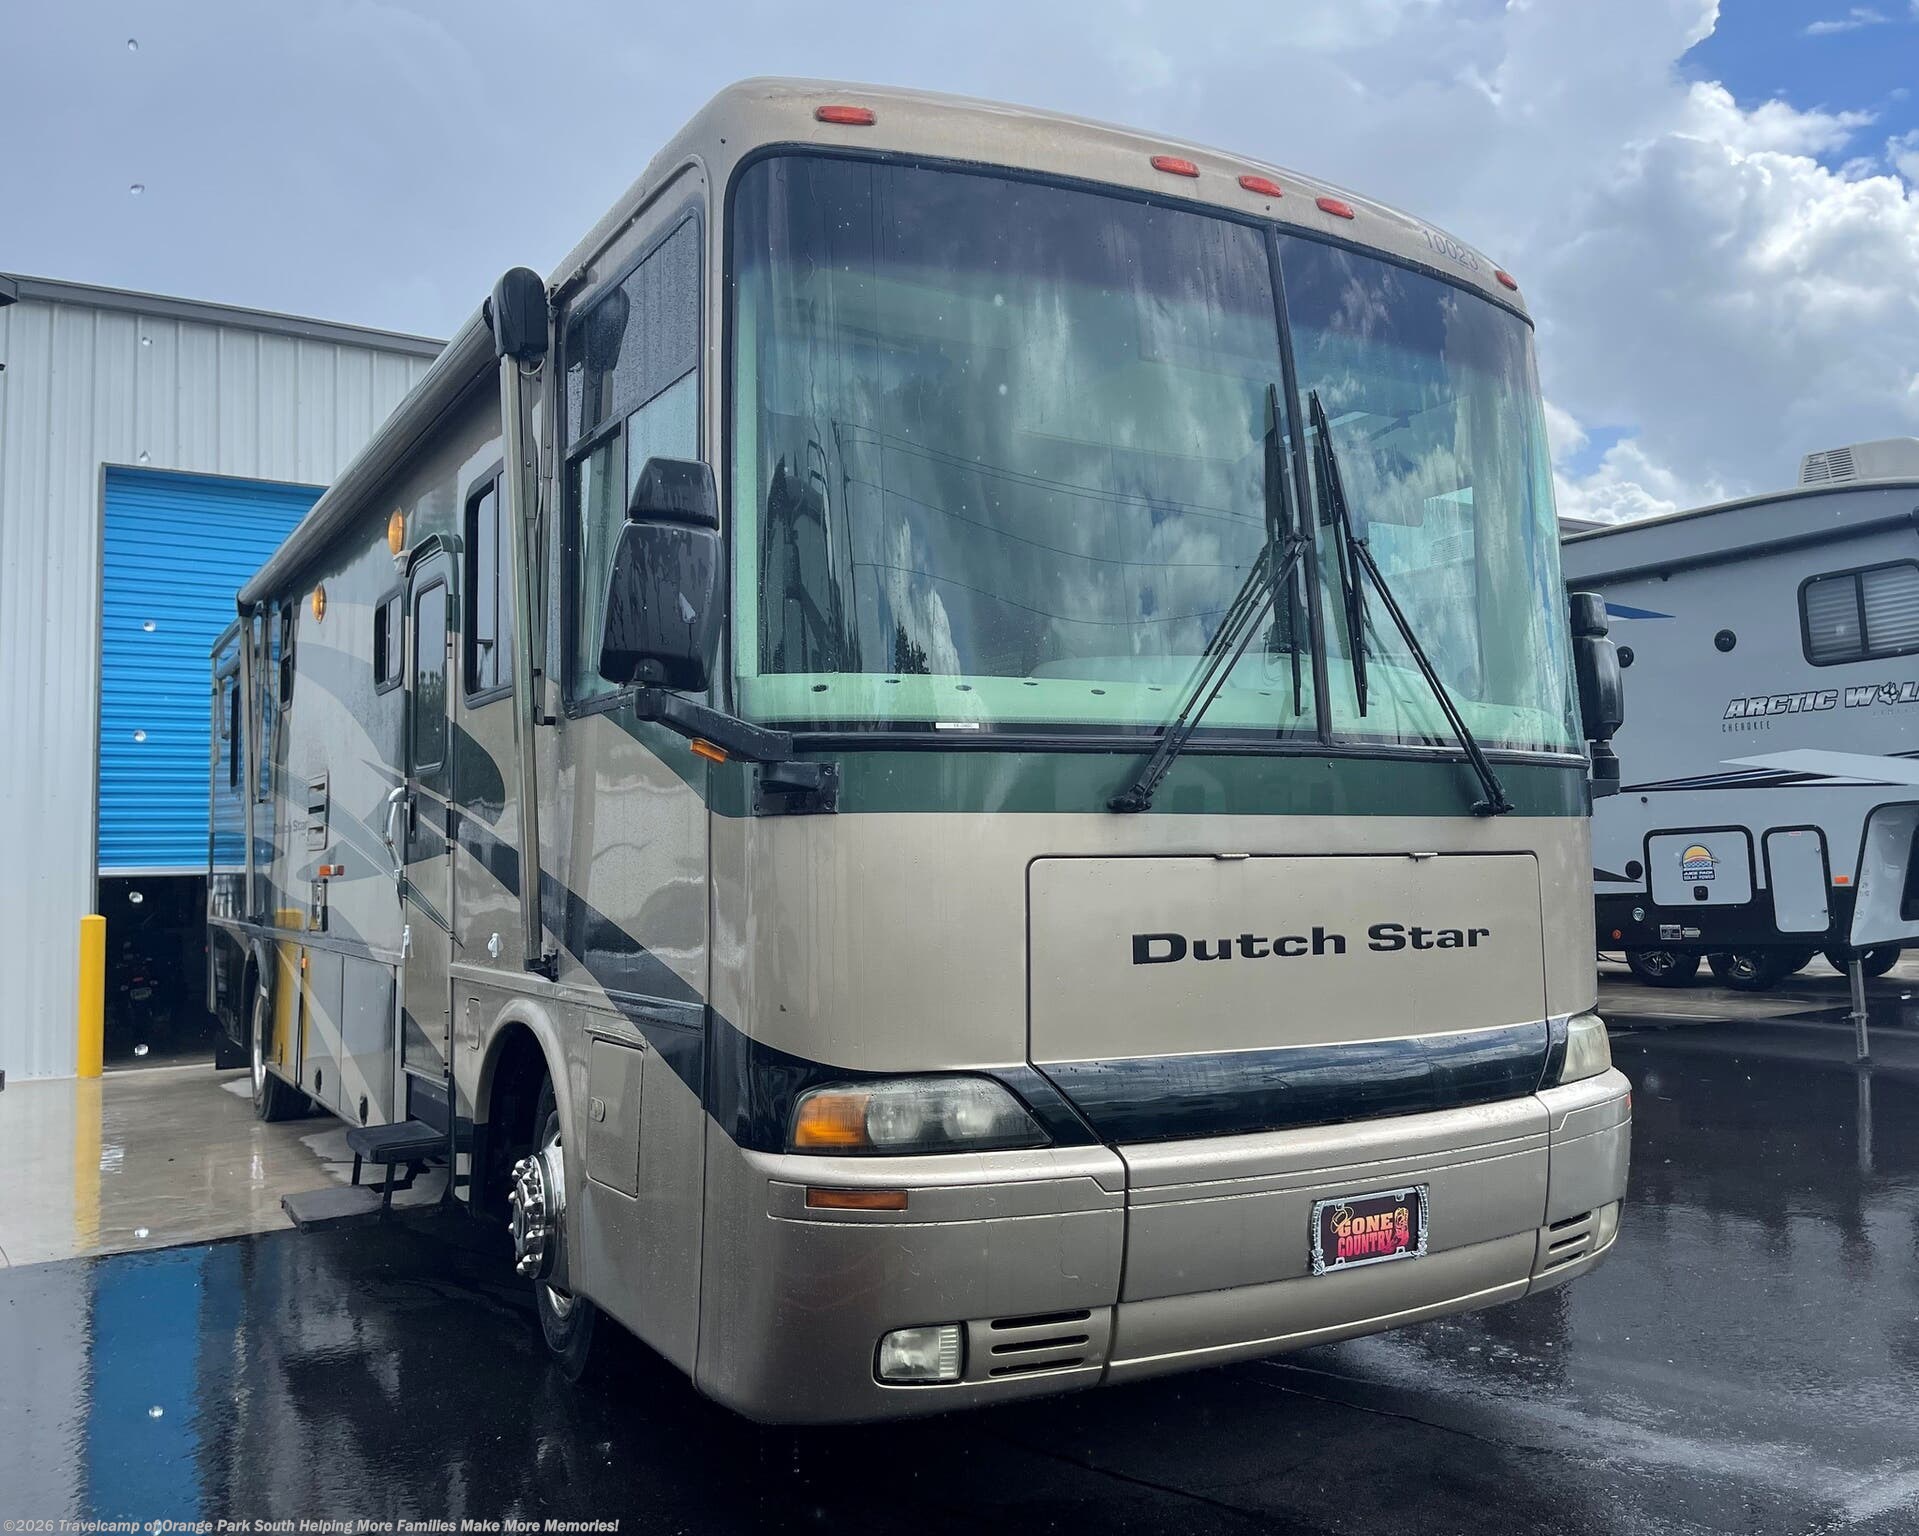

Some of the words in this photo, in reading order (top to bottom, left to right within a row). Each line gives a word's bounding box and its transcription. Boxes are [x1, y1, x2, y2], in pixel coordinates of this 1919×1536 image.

[1424, 230, 1479, 271] 10023
[1723, 690, 1838, 720] ARCTIC
[1722, 720, 1771, 733] CHEROKEE
[1132, 926, 1346, 965] Dutch
[1368, 922, 1490, 952] Star
[1337, 1212, 1394, 1237] GONE
[1337, 1229, 1393, 1257] COUNTRY
